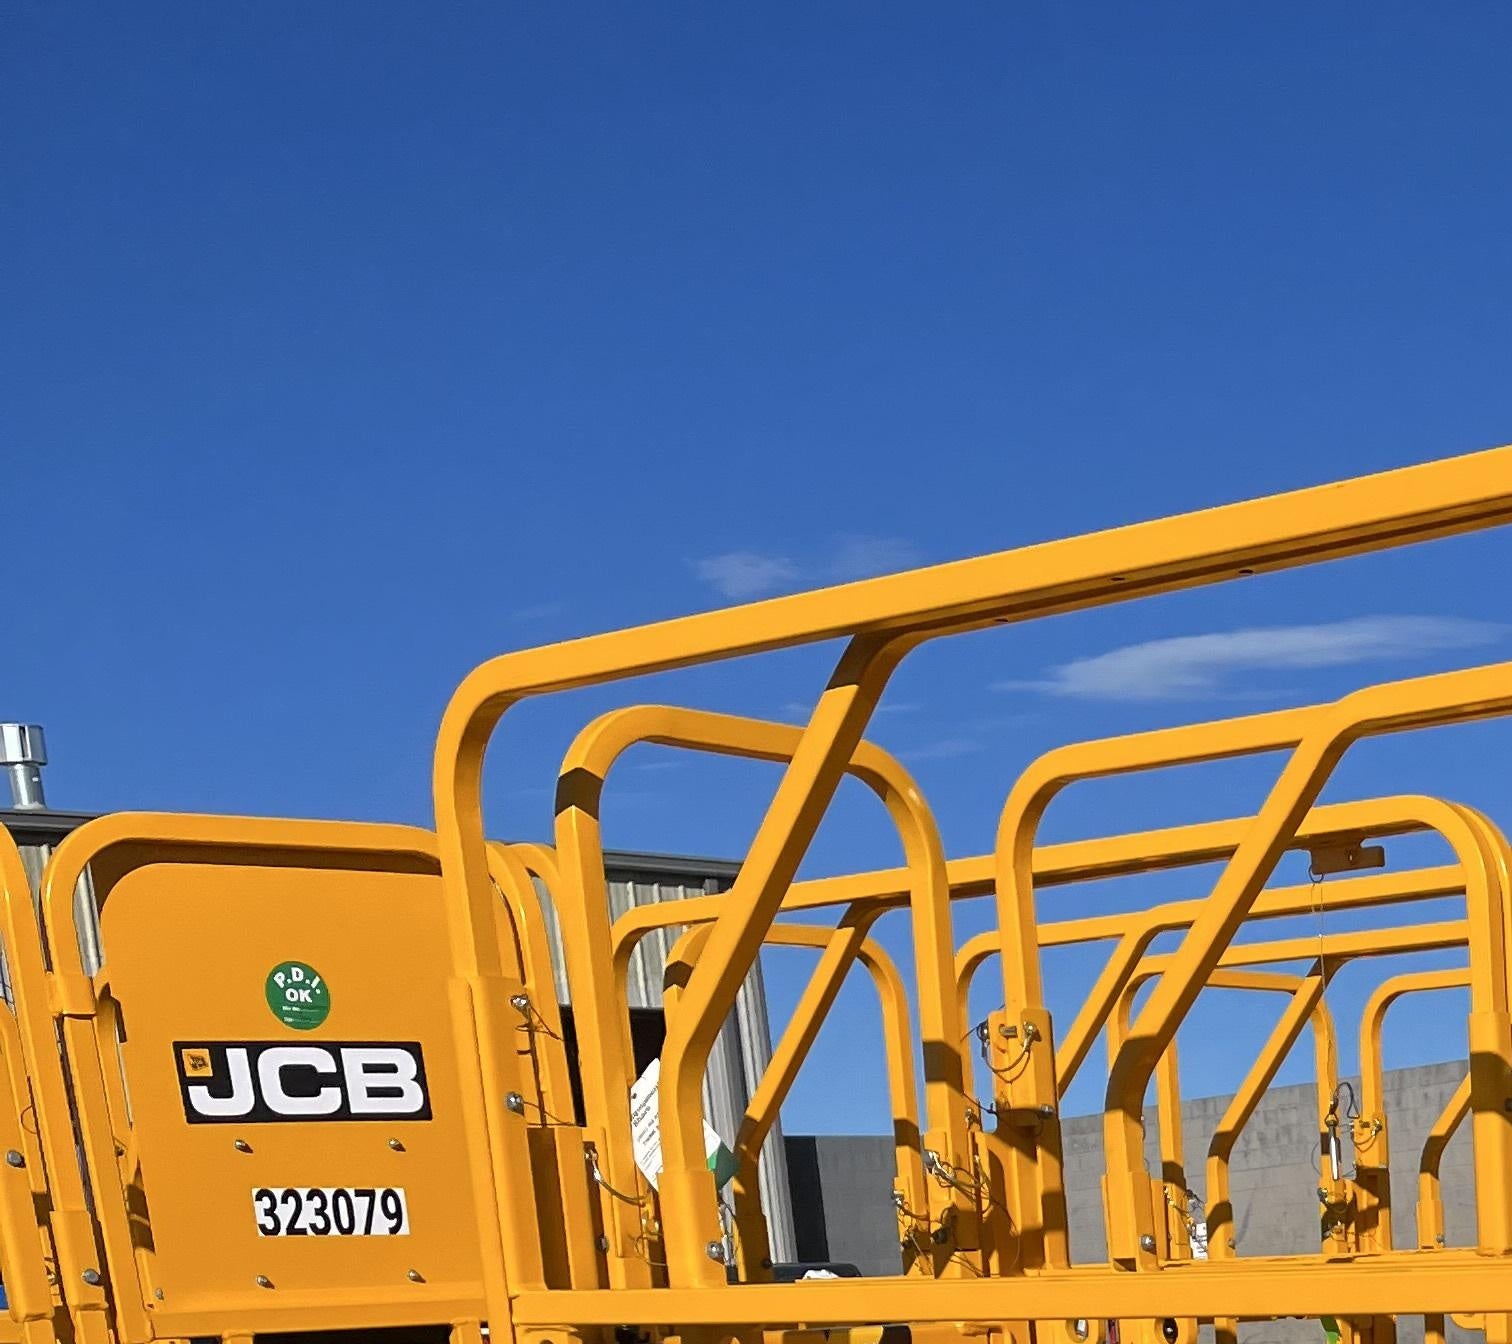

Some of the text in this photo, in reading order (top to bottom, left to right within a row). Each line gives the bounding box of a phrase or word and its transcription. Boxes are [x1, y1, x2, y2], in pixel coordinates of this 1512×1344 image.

[273, 966, 321, 995] P.D.I.
[285, 988, 313, 1003] OK
[188, 1046, 424, 1117] JCB
[254, 1188, 403, 1236] 323079
